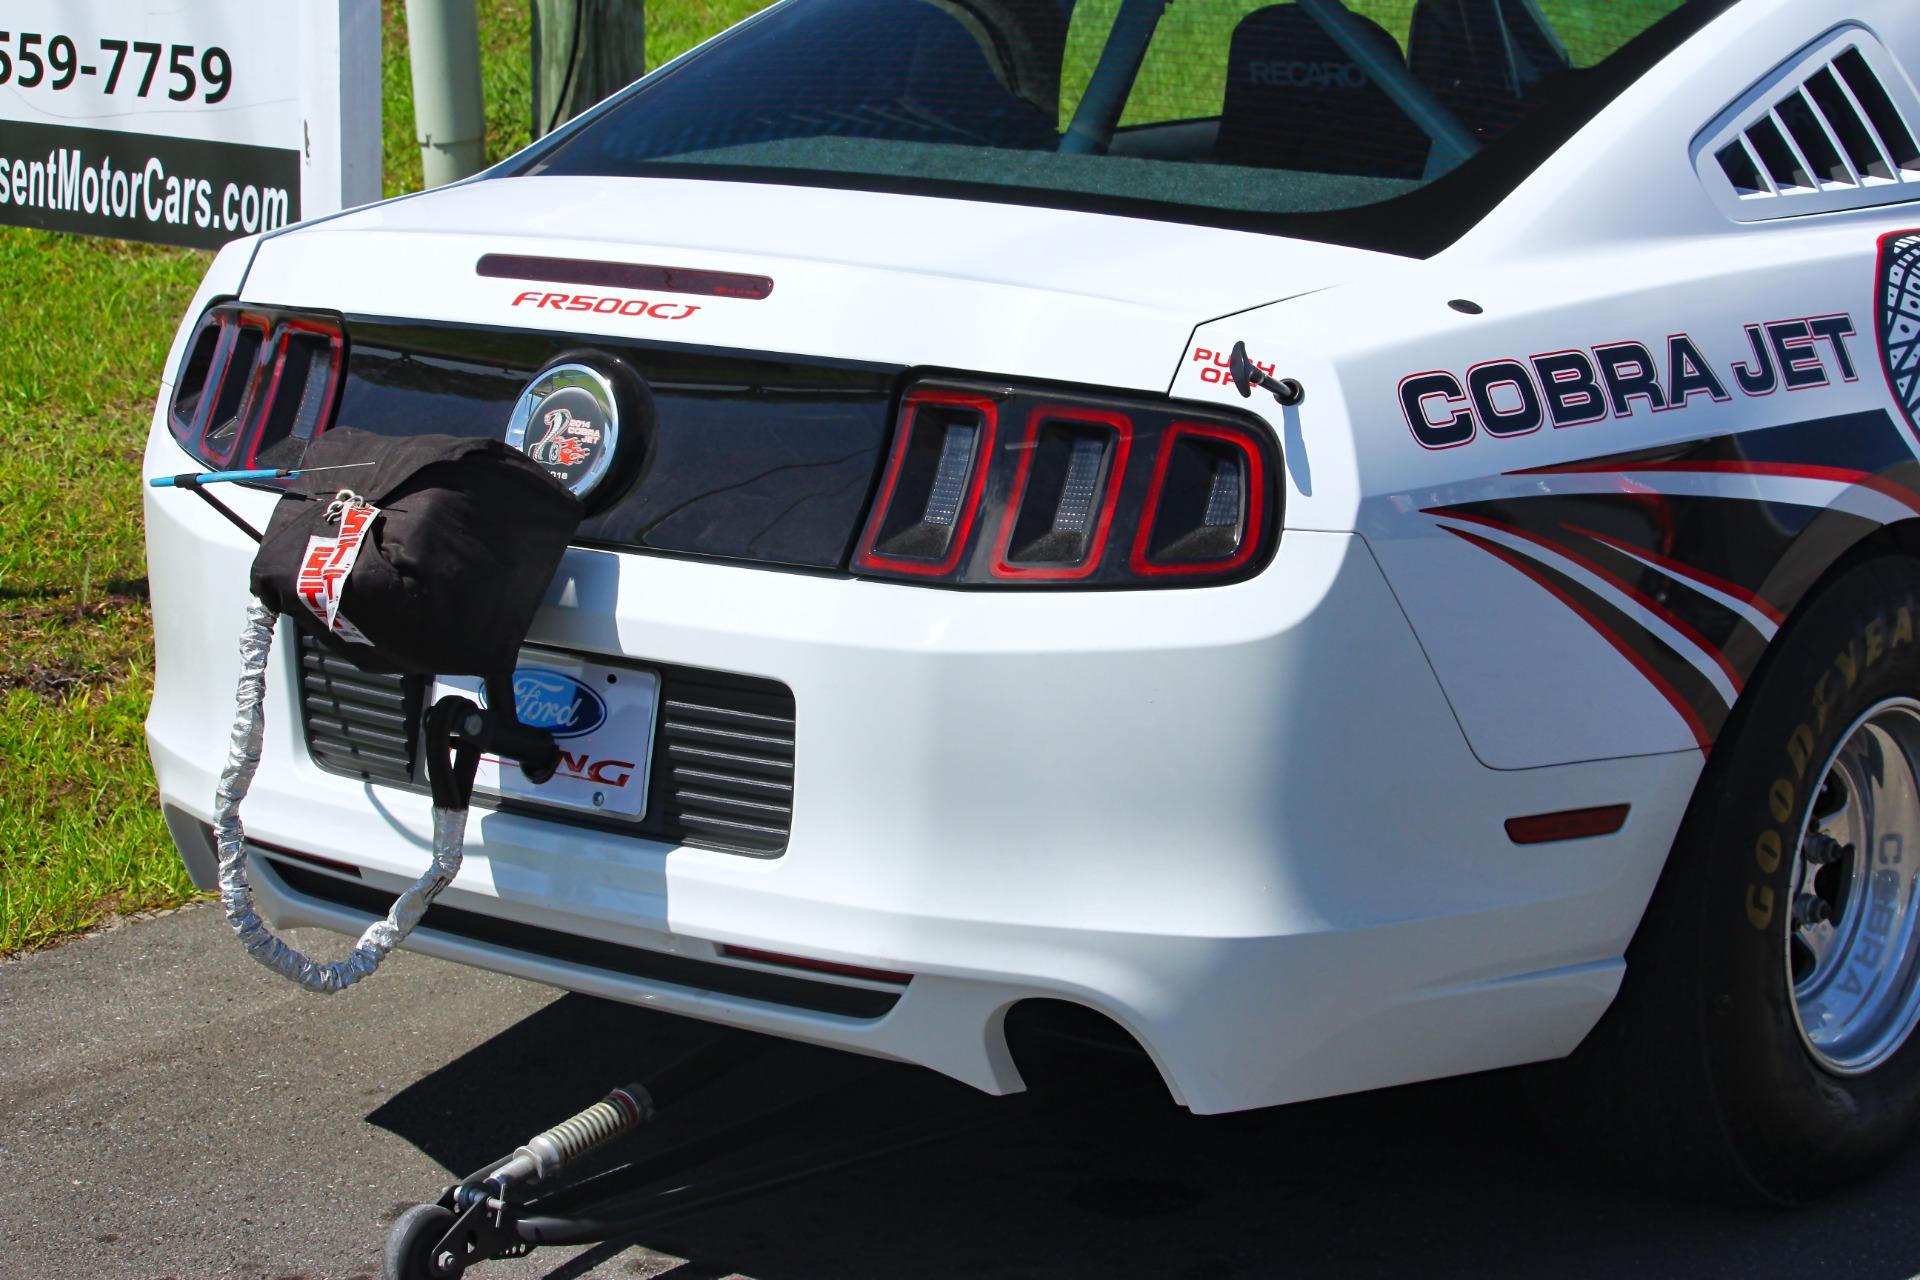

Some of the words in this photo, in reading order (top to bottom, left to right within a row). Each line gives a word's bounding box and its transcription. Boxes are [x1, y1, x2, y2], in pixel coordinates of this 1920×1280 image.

[1248, 61, 1366, 89] RECARO
[511, 291, 701, 320] FR500CJ
[1193, 347, 1276, 378] PUH
[1397, 333, 1732, 451] COBRA
[1731, 312, 1859, 398] JET
[568, 427, 600, 437] COBRA
[581, 436, 600, 444] JET
[514, 677, 582, 727] Ford
